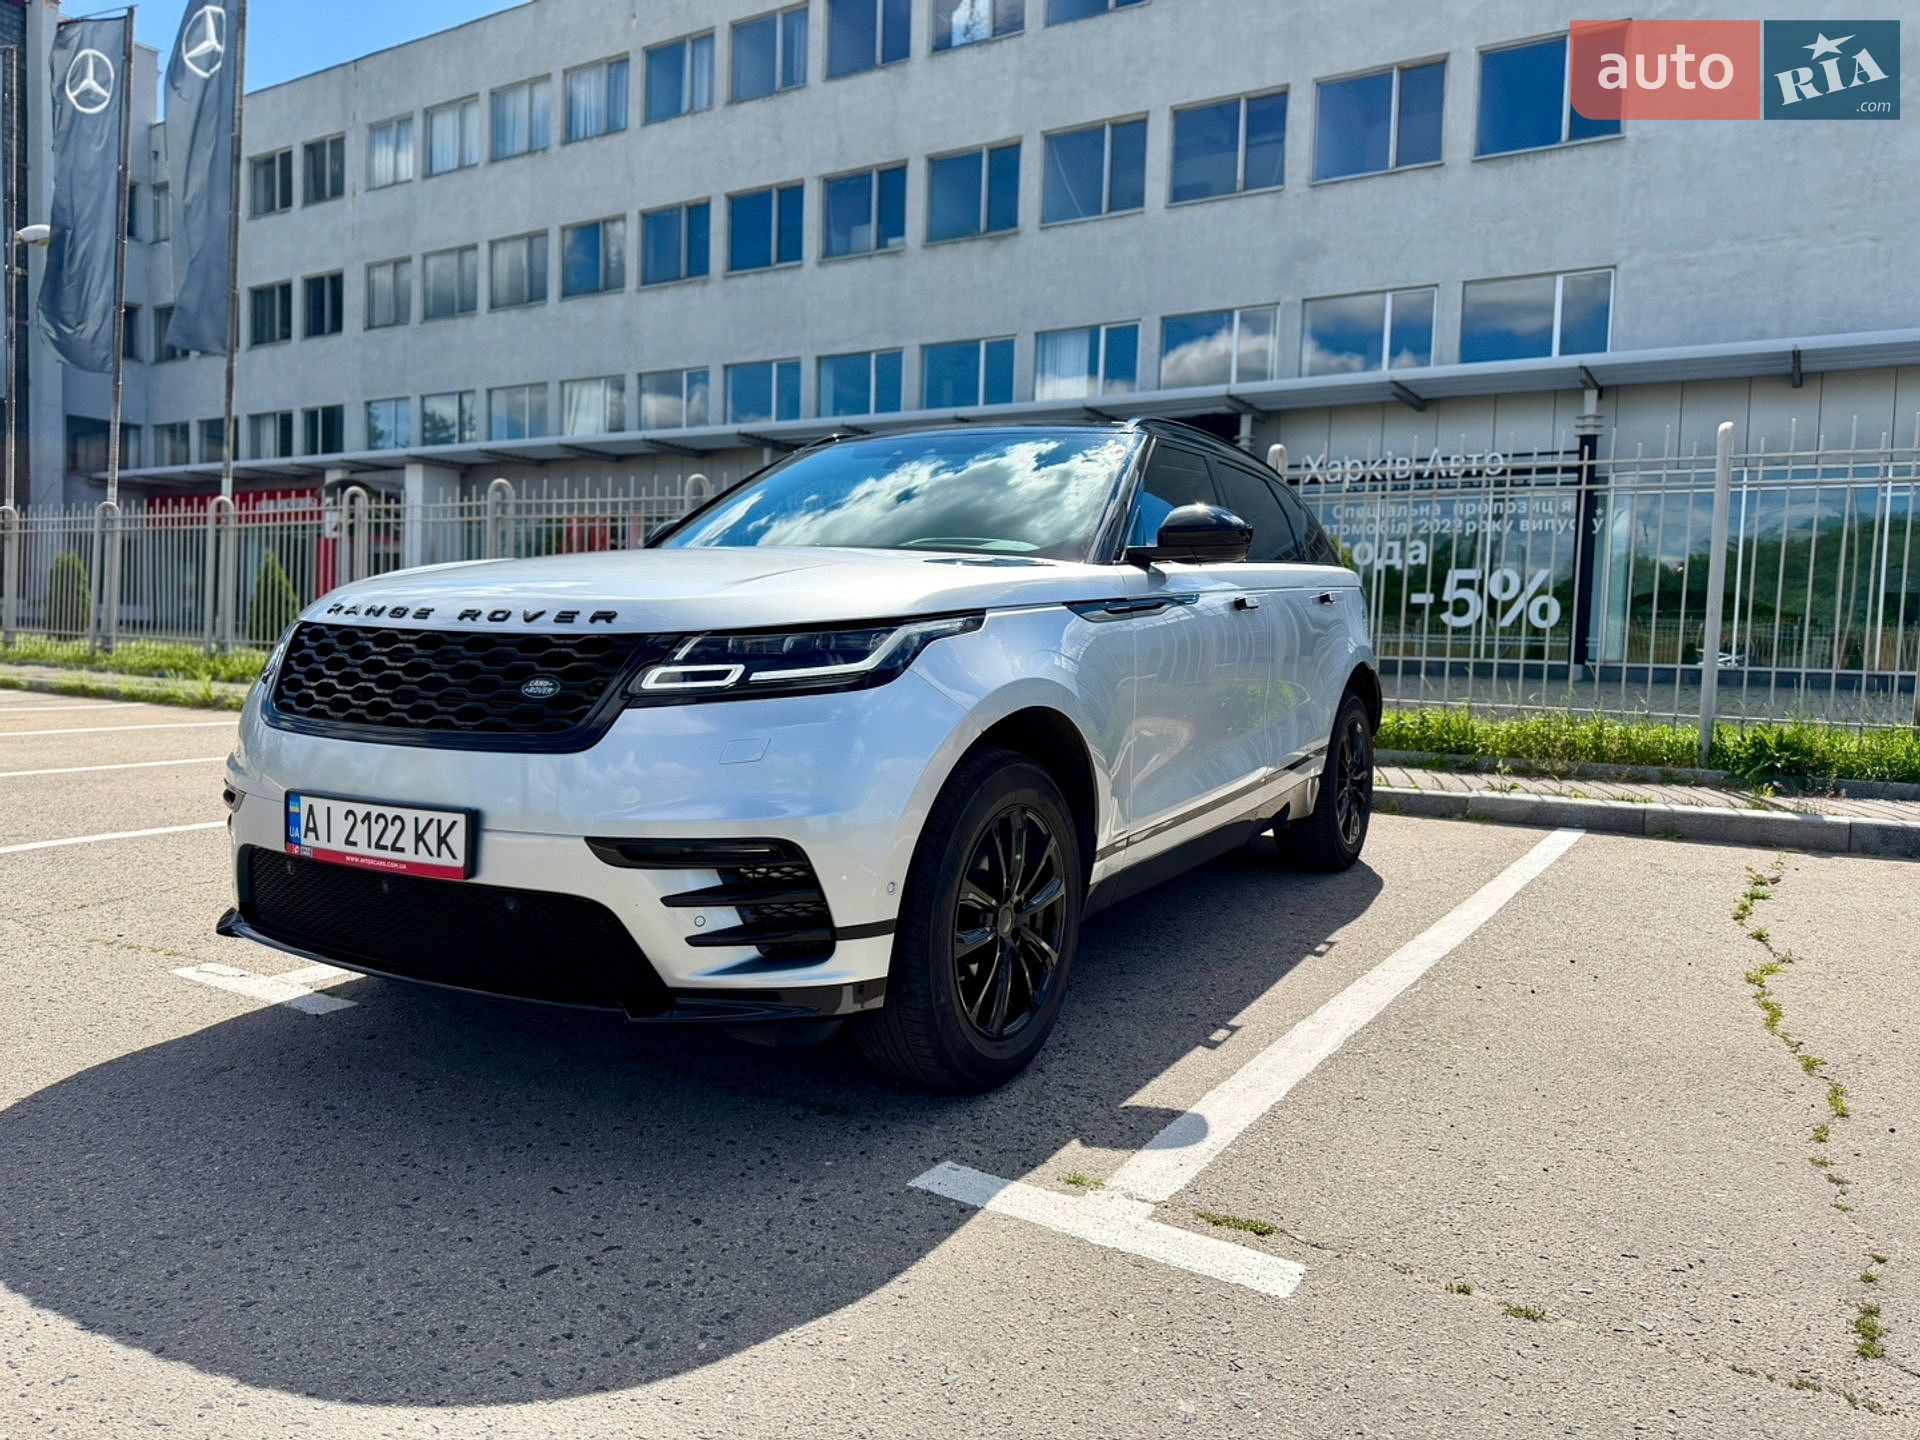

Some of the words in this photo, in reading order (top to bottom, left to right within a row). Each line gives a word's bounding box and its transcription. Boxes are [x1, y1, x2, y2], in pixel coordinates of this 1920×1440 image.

[1453, 500, 1571, 519] пропозиця
[1410, 567, 1561, 629] -5%
[327, 602, 435, 620] RANGE
[457, 608, 619, 624] ROVER
[289, 825, 300, 838] UA
[344, 809, 406, 854] 2122
[414, 816, 458, 861] KK
